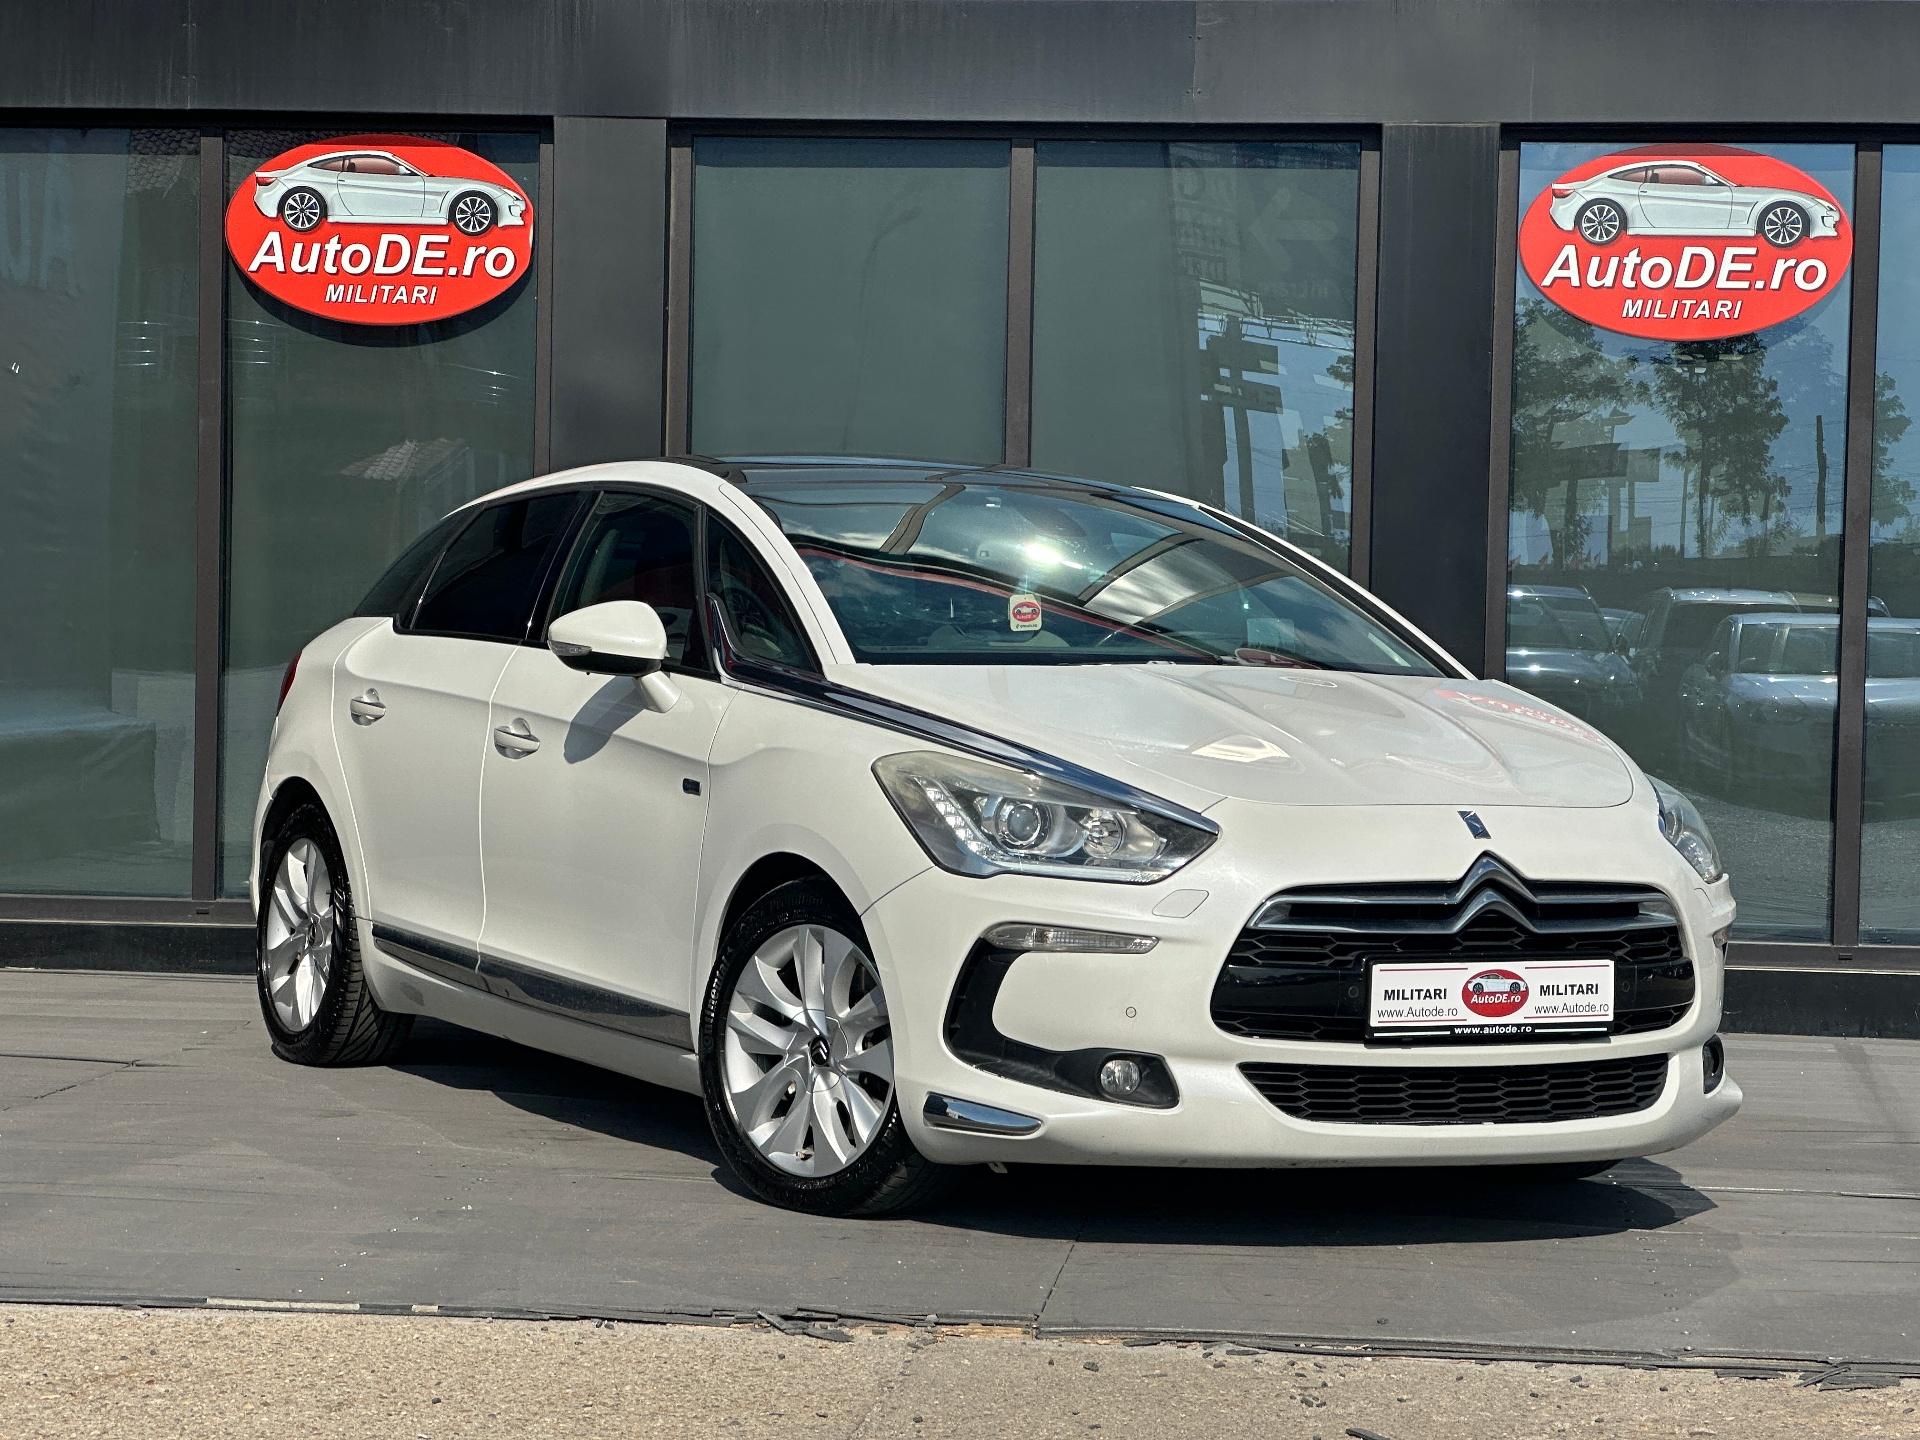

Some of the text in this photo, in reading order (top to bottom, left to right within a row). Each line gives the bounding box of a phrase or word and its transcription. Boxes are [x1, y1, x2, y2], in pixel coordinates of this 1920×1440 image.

[248, 231, 516, 278] AutoDE.ro
[1541, 244, 1828, 291] AutoDE.ro
[324, 284, 437, 304] MILITARI
[1621, 299, 1742, 319] MILITARI
[1384, 988, 1447, 1001] MILITARI
[1539, 983, 1599, 997] MILITARI
[1471, 994, 1521, 1004] AutoDE.ro
[1377, 1006, 1458, 1018] www.Autode.ro
[1534, 1002, 1609, 1015] www.Autode.ro
[1454, 1024, 1532, 1034] www.autode.ro
